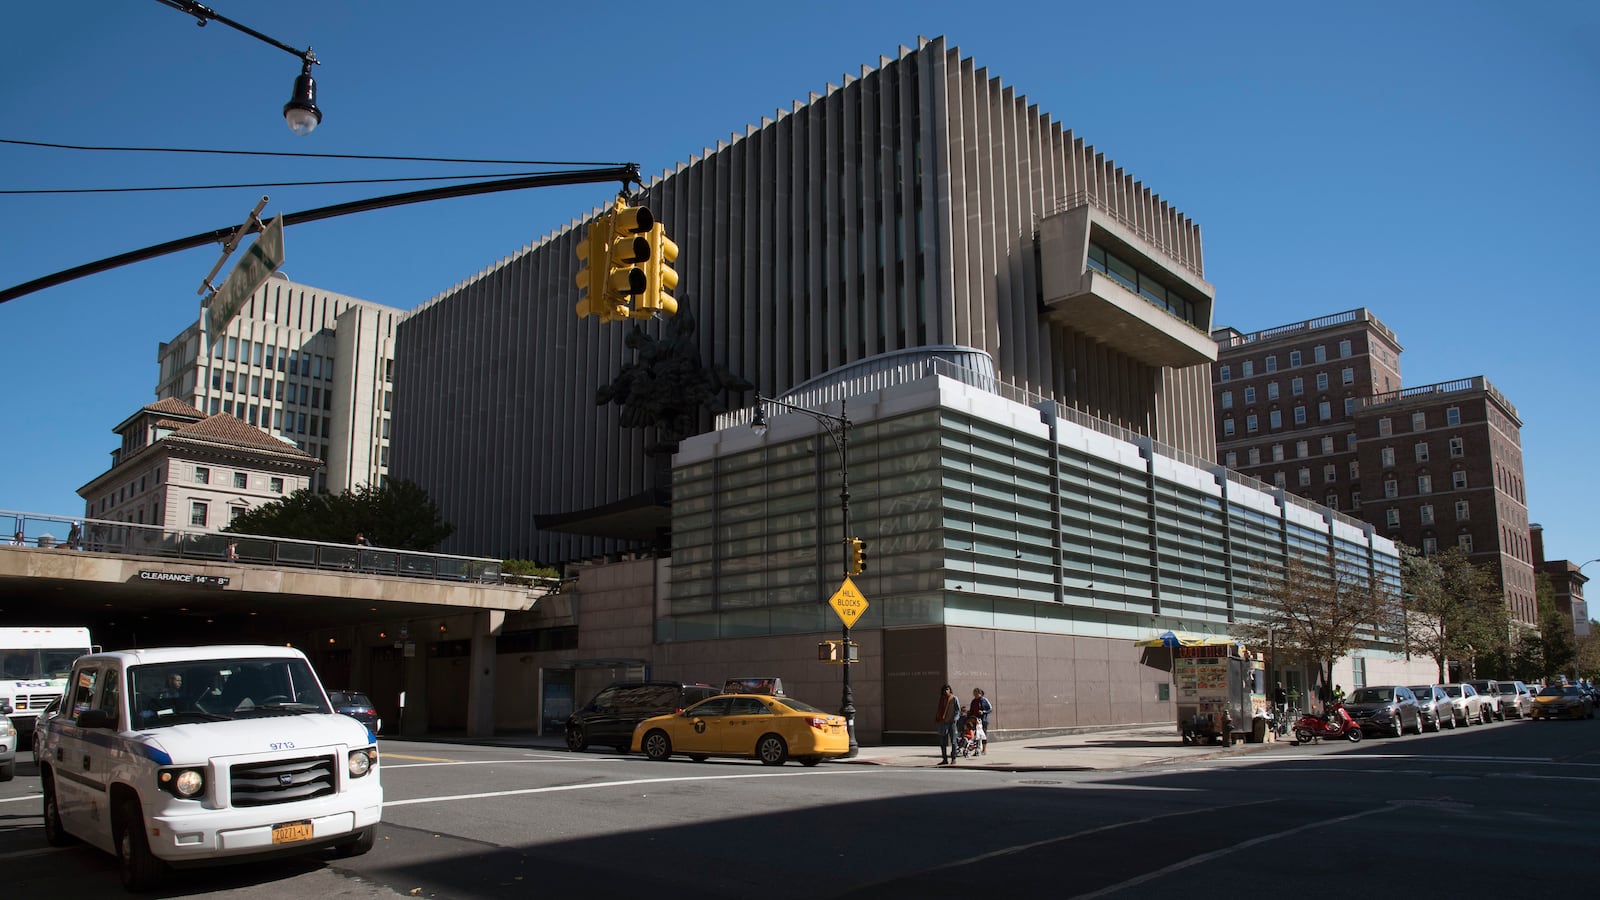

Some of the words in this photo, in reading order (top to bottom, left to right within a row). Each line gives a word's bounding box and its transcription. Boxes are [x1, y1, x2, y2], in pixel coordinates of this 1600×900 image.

[141, 572, 191, 582] CLEARANCE
[842, 589, 855, 597] HILL
[838, 598, 861, 607] BLOCKS
[843, 608, 856, 616] VIEW
[270, 741, 295, 750] 9713
